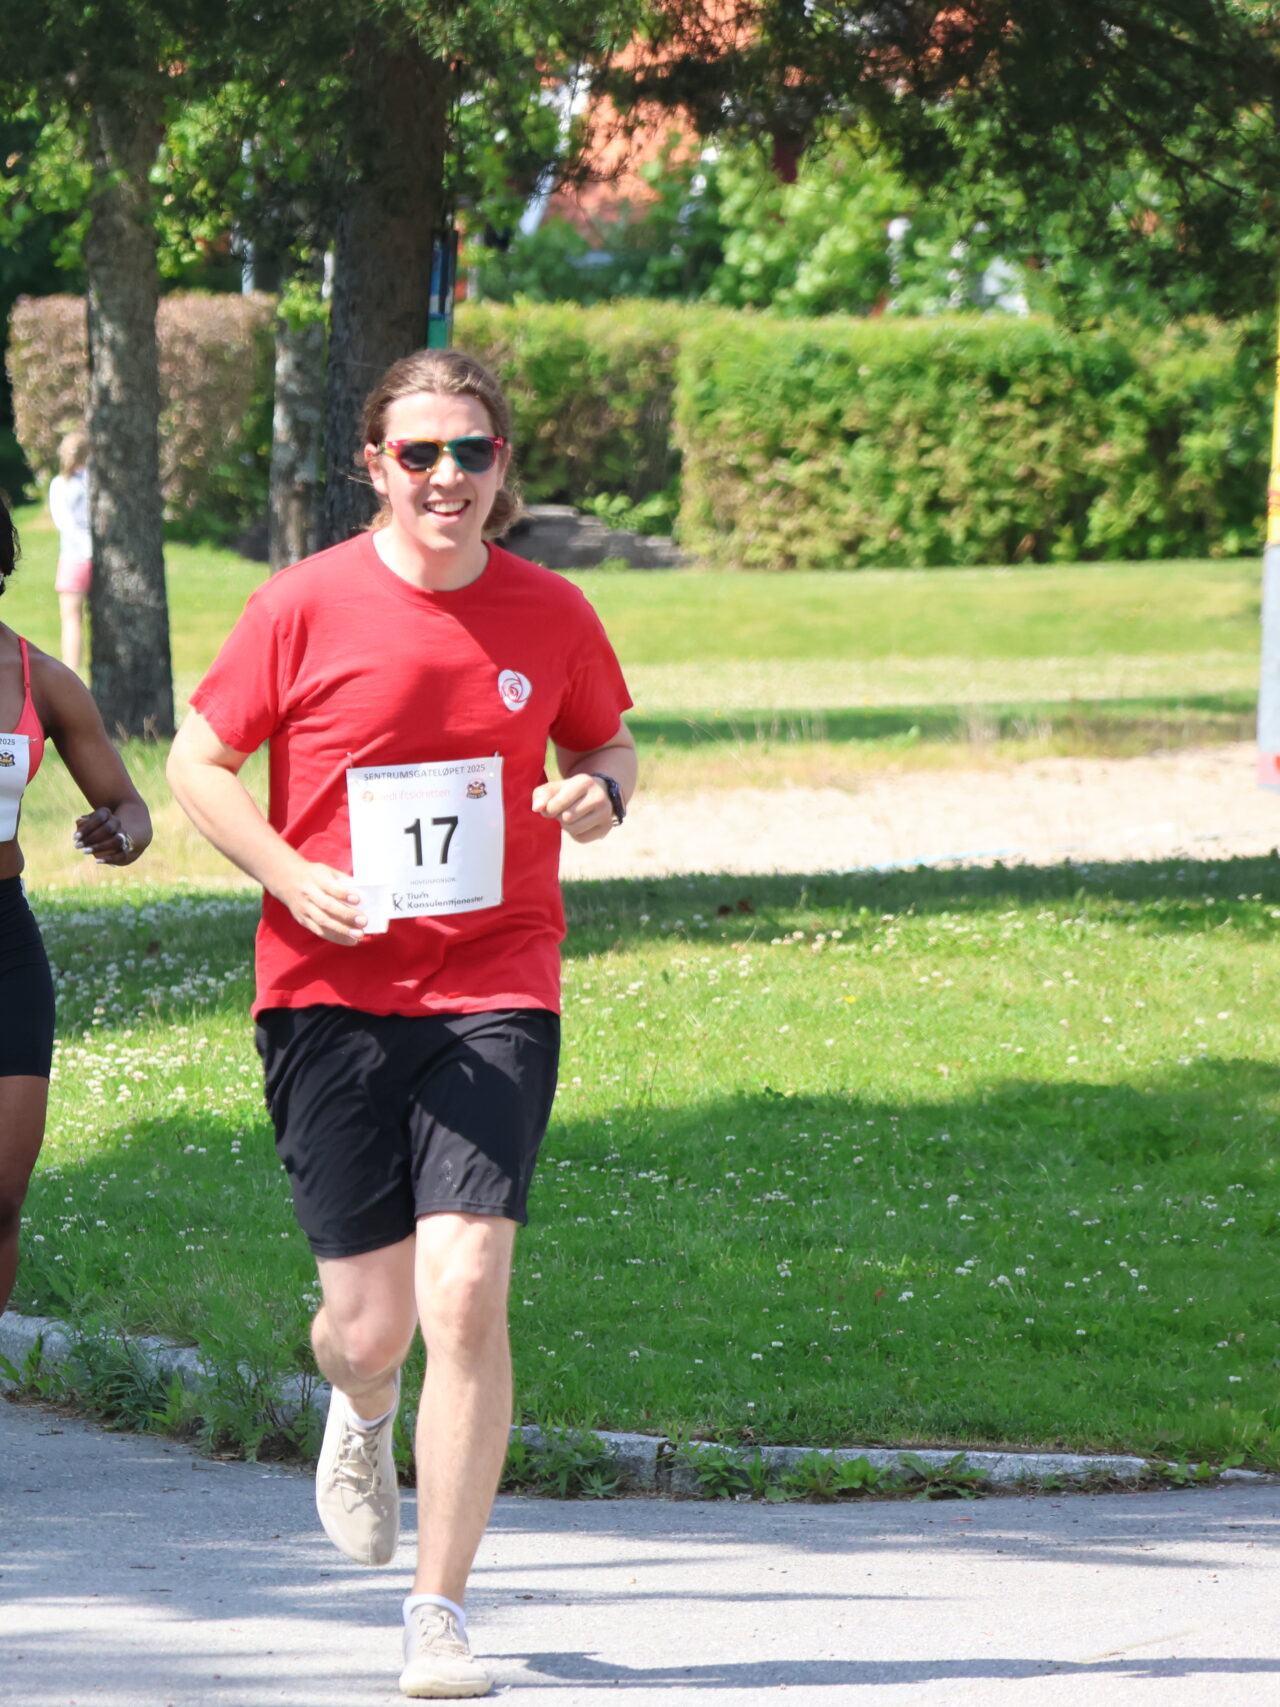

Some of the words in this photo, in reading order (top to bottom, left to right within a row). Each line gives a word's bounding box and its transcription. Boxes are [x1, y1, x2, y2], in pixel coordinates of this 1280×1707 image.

[363, 765, 464, 781] SENTRUMSGATELØPET
[467, 764, 486, 774] 2025
[404, 816, 459, 866] 17
